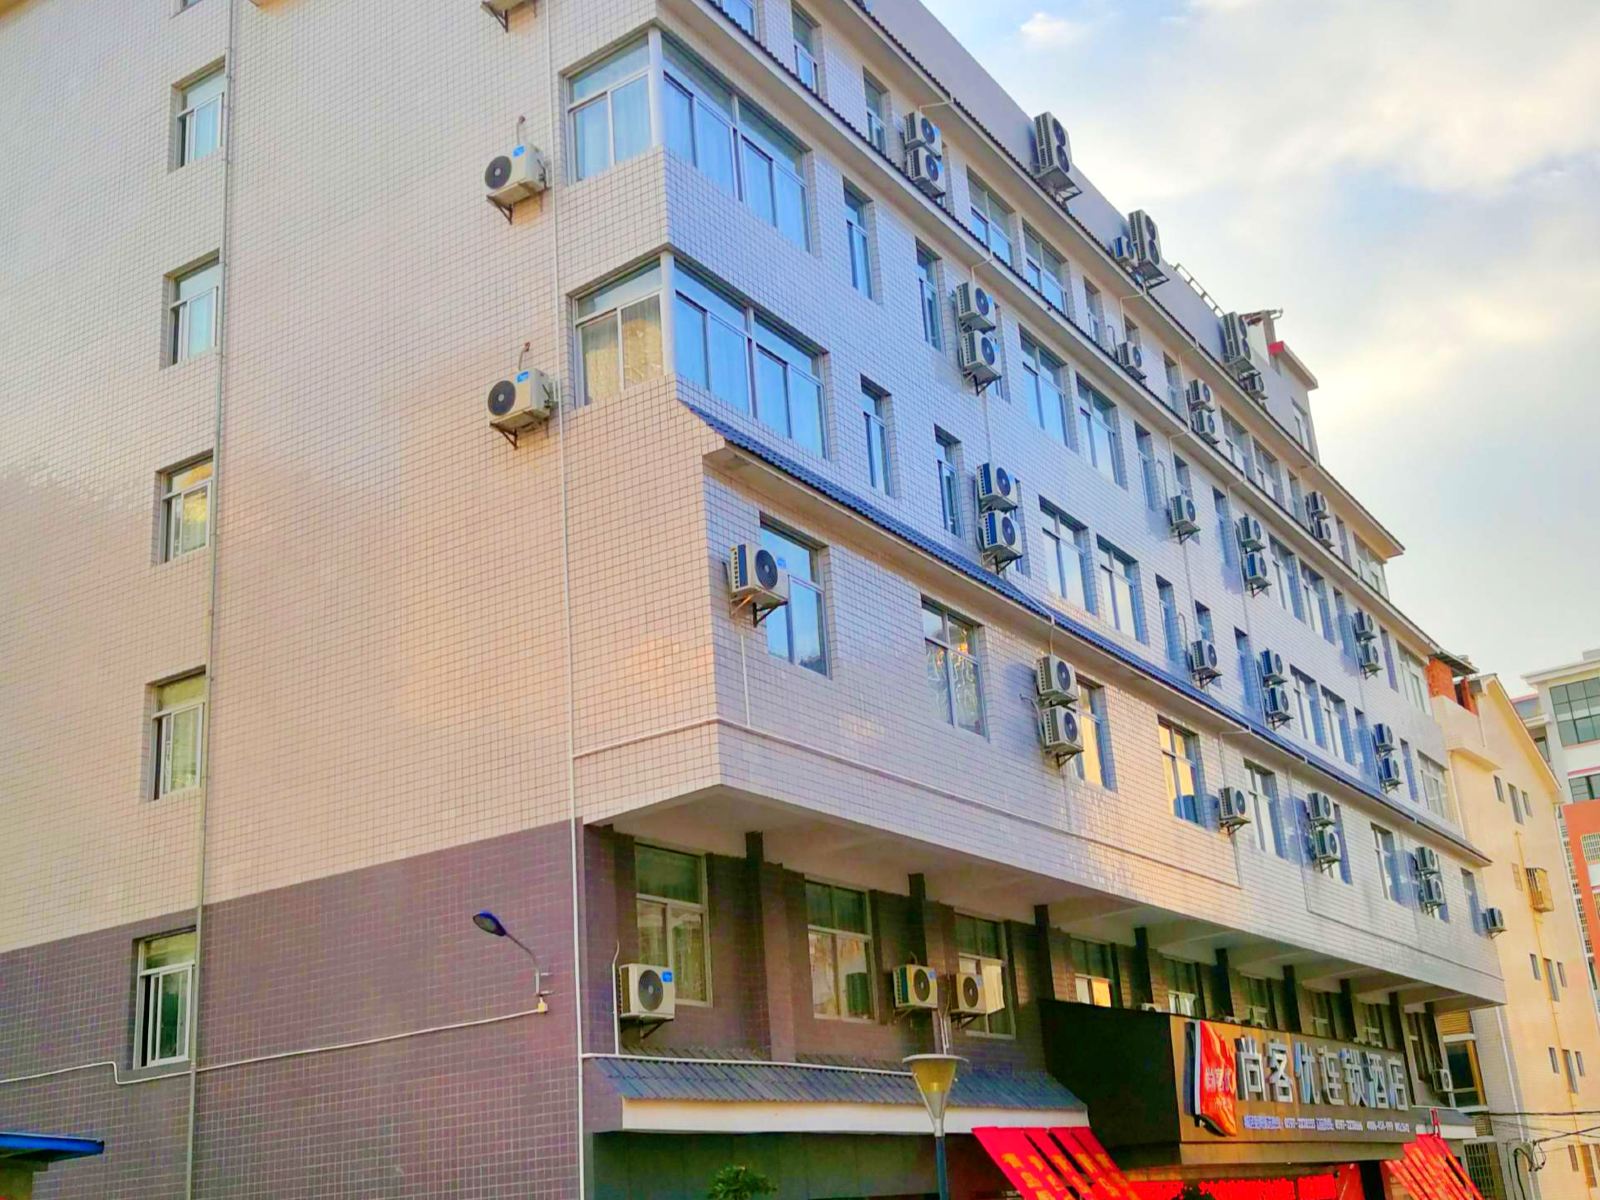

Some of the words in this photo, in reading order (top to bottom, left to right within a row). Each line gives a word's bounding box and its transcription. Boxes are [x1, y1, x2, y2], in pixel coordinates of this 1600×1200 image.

[1237, 1036, 1409, 1111] 尚客优连锁酒店
